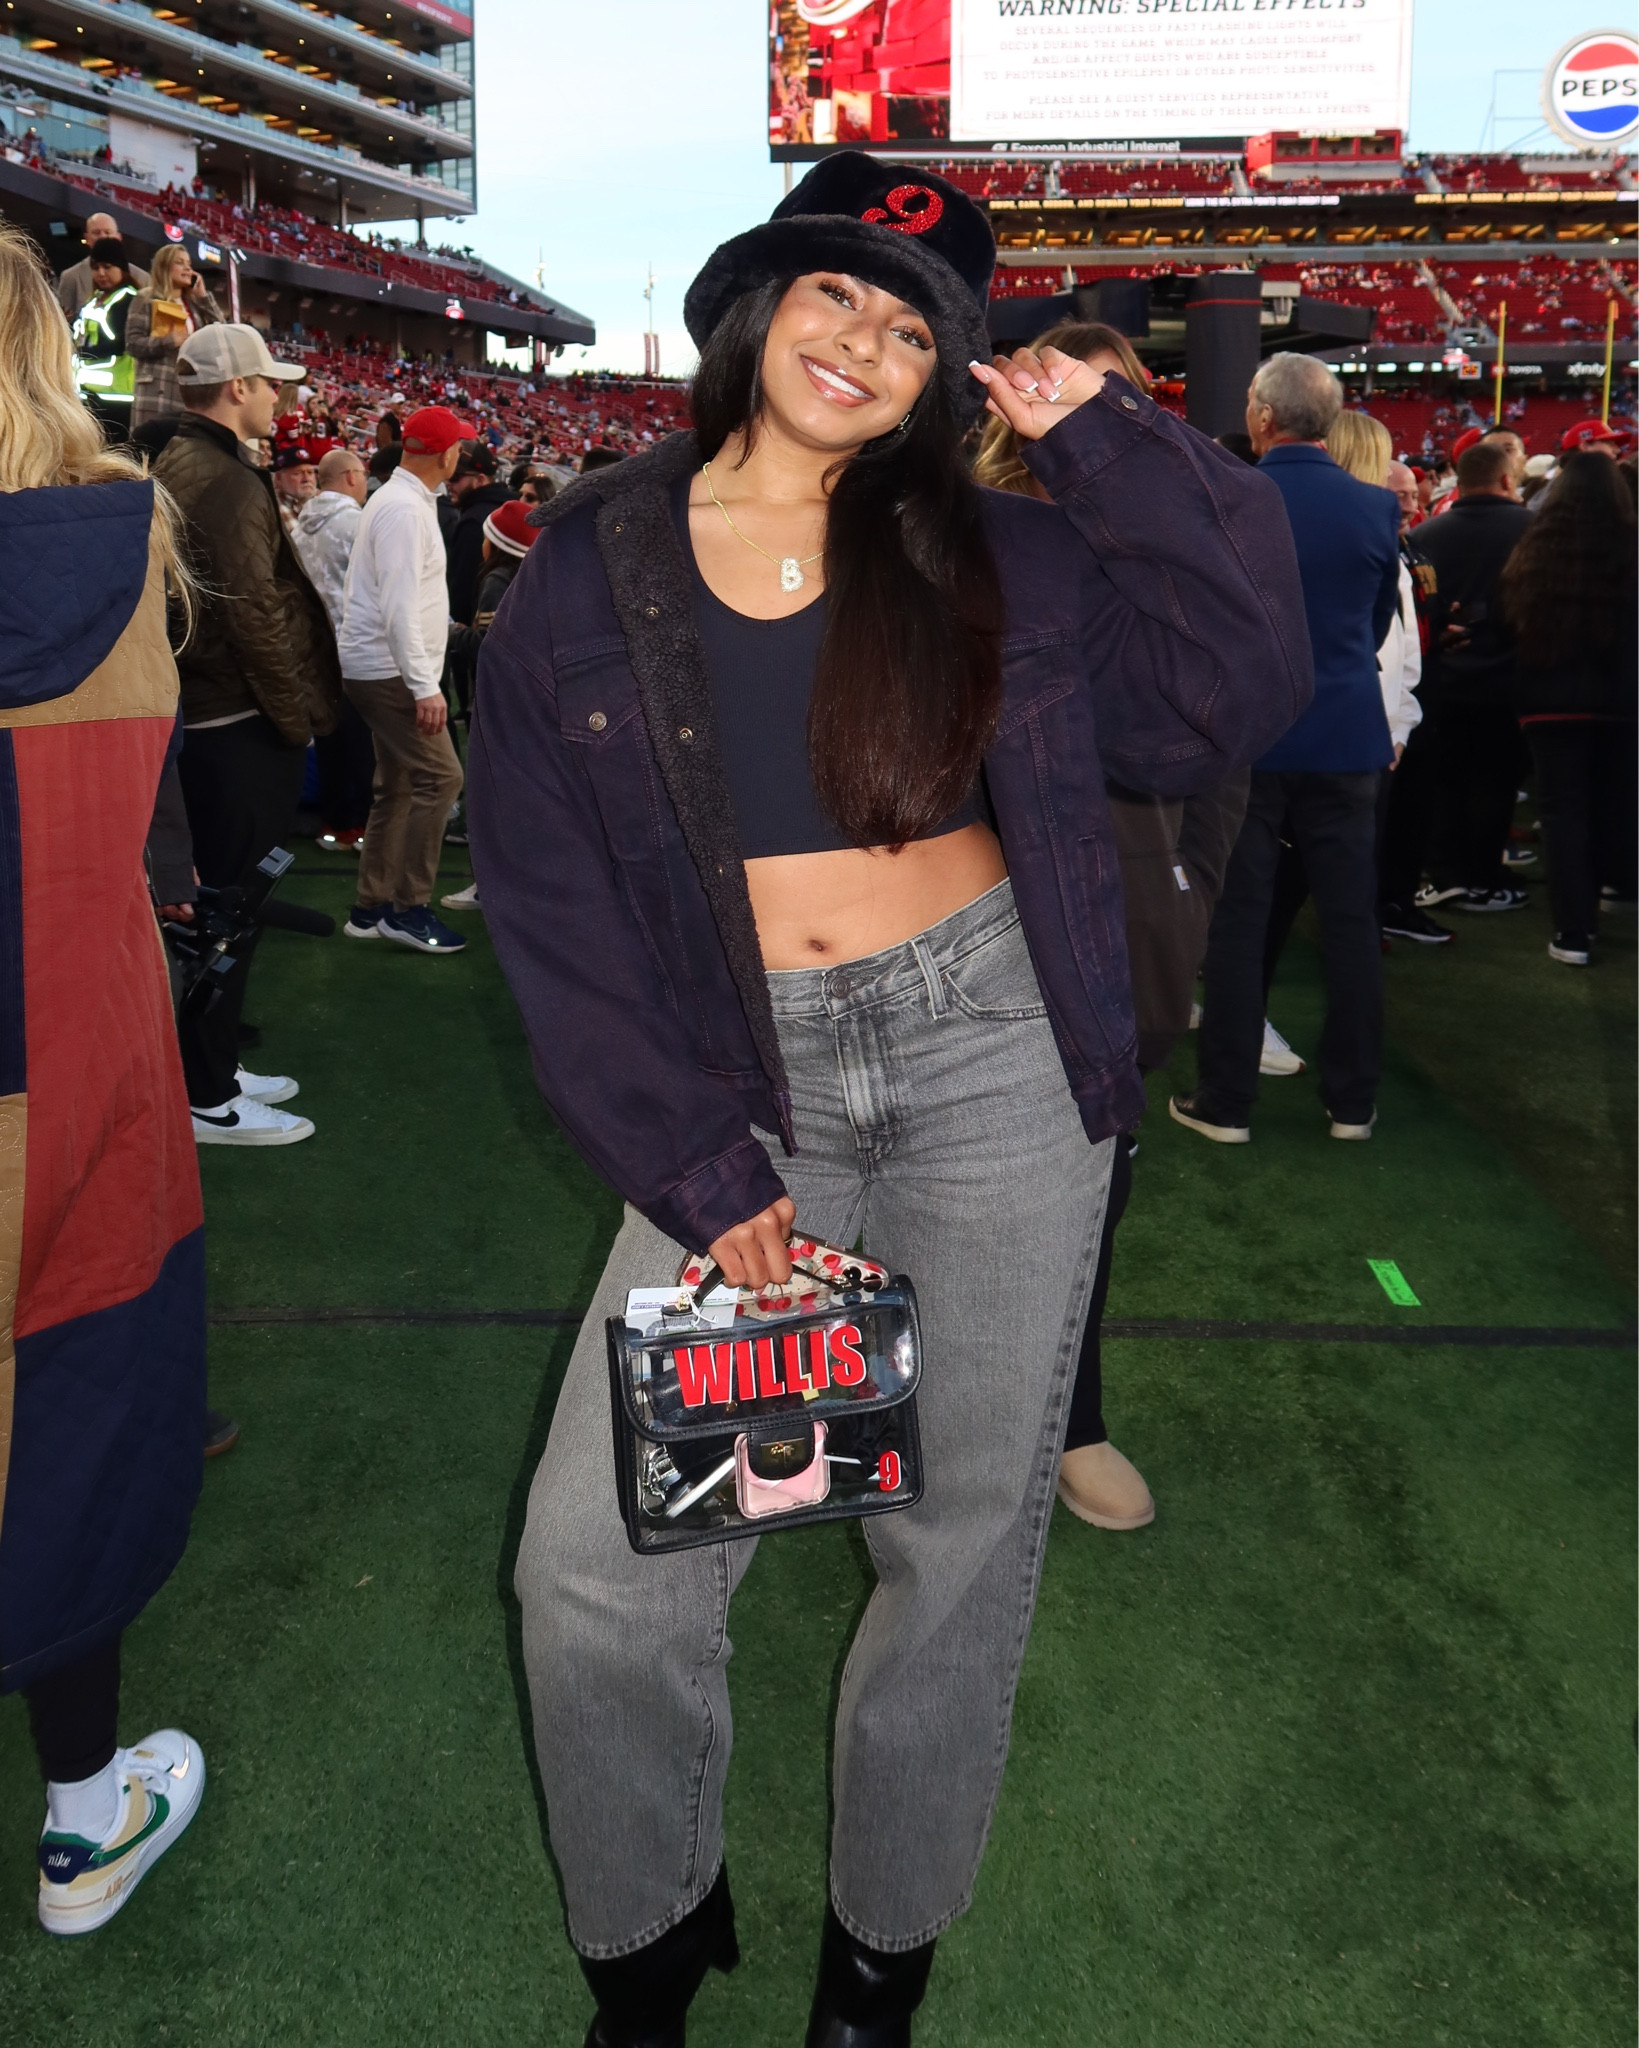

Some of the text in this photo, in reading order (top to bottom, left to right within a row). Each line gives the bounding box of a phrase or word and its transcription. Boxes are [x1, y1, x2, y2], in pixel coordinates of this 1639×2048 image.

[998, 0, 1367, 17] WARNING: SPECIAL EFFECTS
[1016, 20, 1347, 35] SEVERAL SEQUENCES OF FAST FLASHING LIGHTS WILL
[1000, 41, 1039, 50] OCCUR
[1044, 40, 1089, 49] DURING
[1094, 40, 1117, 48] THE
[1164, 38, 1205, 46] WHICH
[1210, 37, 1235, 46] MAY
[1240, 36, 1278, 44] CAUSE
[1284, 34, 1362, 44] DISCOMFORT
[1032, 50, 1327, 64] AND/OR AFFECT GUESTS WHO ARE SUSCEPTIBLE
[984, 64, 1375, 80] TO PHOTOSENSITIVE EPILEPSY OR OTHER PHOTO SENSITIVITIES
[1029, 90, 1328, 104] PLEASE SEE A GUEST SERVICES REPRESENTATIVE
[986, 104, 1372, 120] FOR MORE DETAILS ON THE TIMING OF THESE SPECIAL EFFECTS
[1068, 141, 1128, 152] Industrial
[1130, 140, 1180, 152] Internet
[861, 184, 944, 235] 9
[1508, 365, 1542, 374] TOYOTA
[1567, 362, 1607, 378] xfinity
[673, 1324, 867, 1408] WILLIS
[878, 1450, 902, 1492] 9
[48, 1852, 72, 1868] nike
[102, 1875, 123, 1902] AIR
